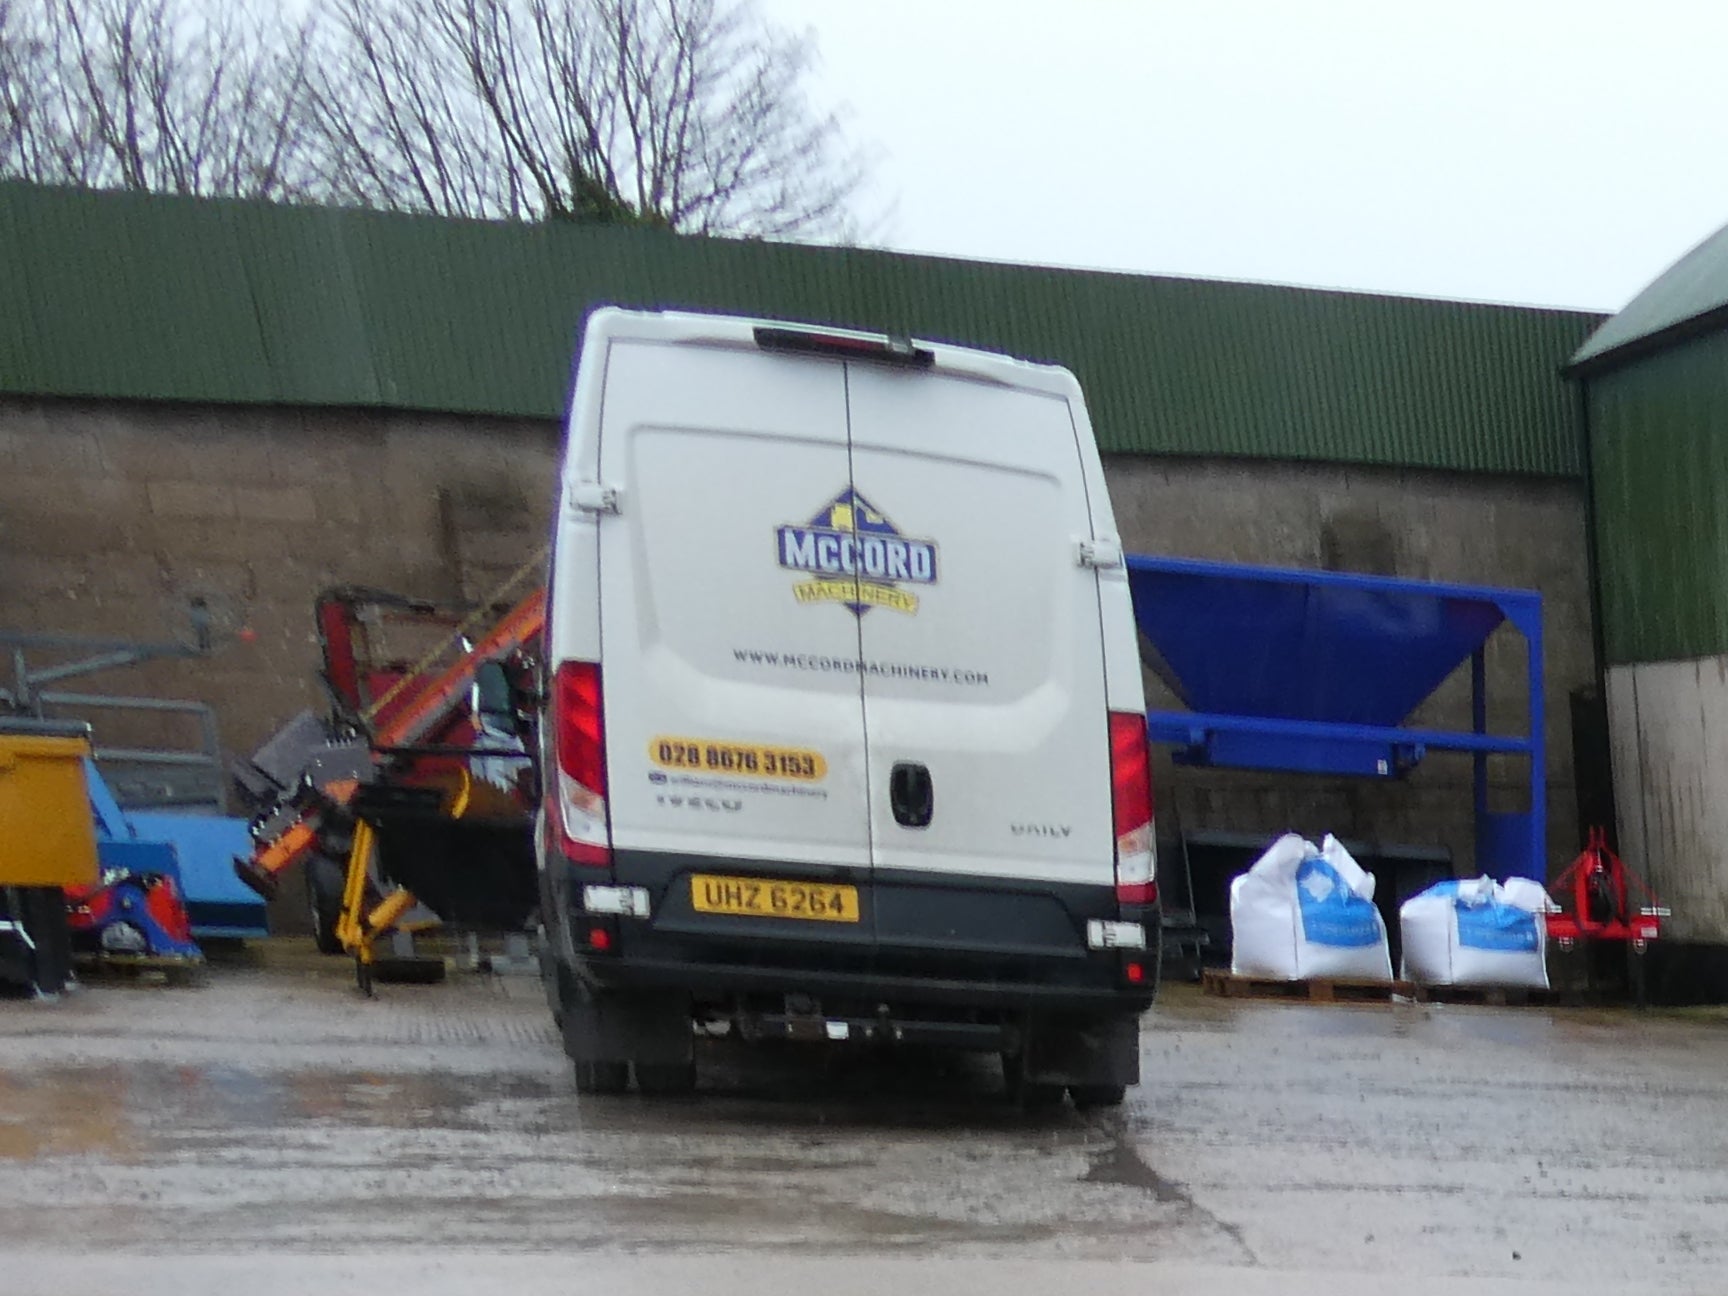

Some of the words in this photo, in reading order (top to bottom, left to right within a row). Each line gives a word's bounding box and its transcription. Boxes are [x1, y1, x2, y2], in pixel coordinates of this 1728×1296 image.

[784, 530, 932, 580] MCCORD
[799, 581, 910, 608] MACHINERY
[733, 649, 989, 685] WWW.MCCORDMACHINERY.COM
[659, 741, 700, 767] 028
[764, 751, 816, 780] 3153
[705, 881, 764, 910] UHZ
[771, 887, 845, 914] 6264
